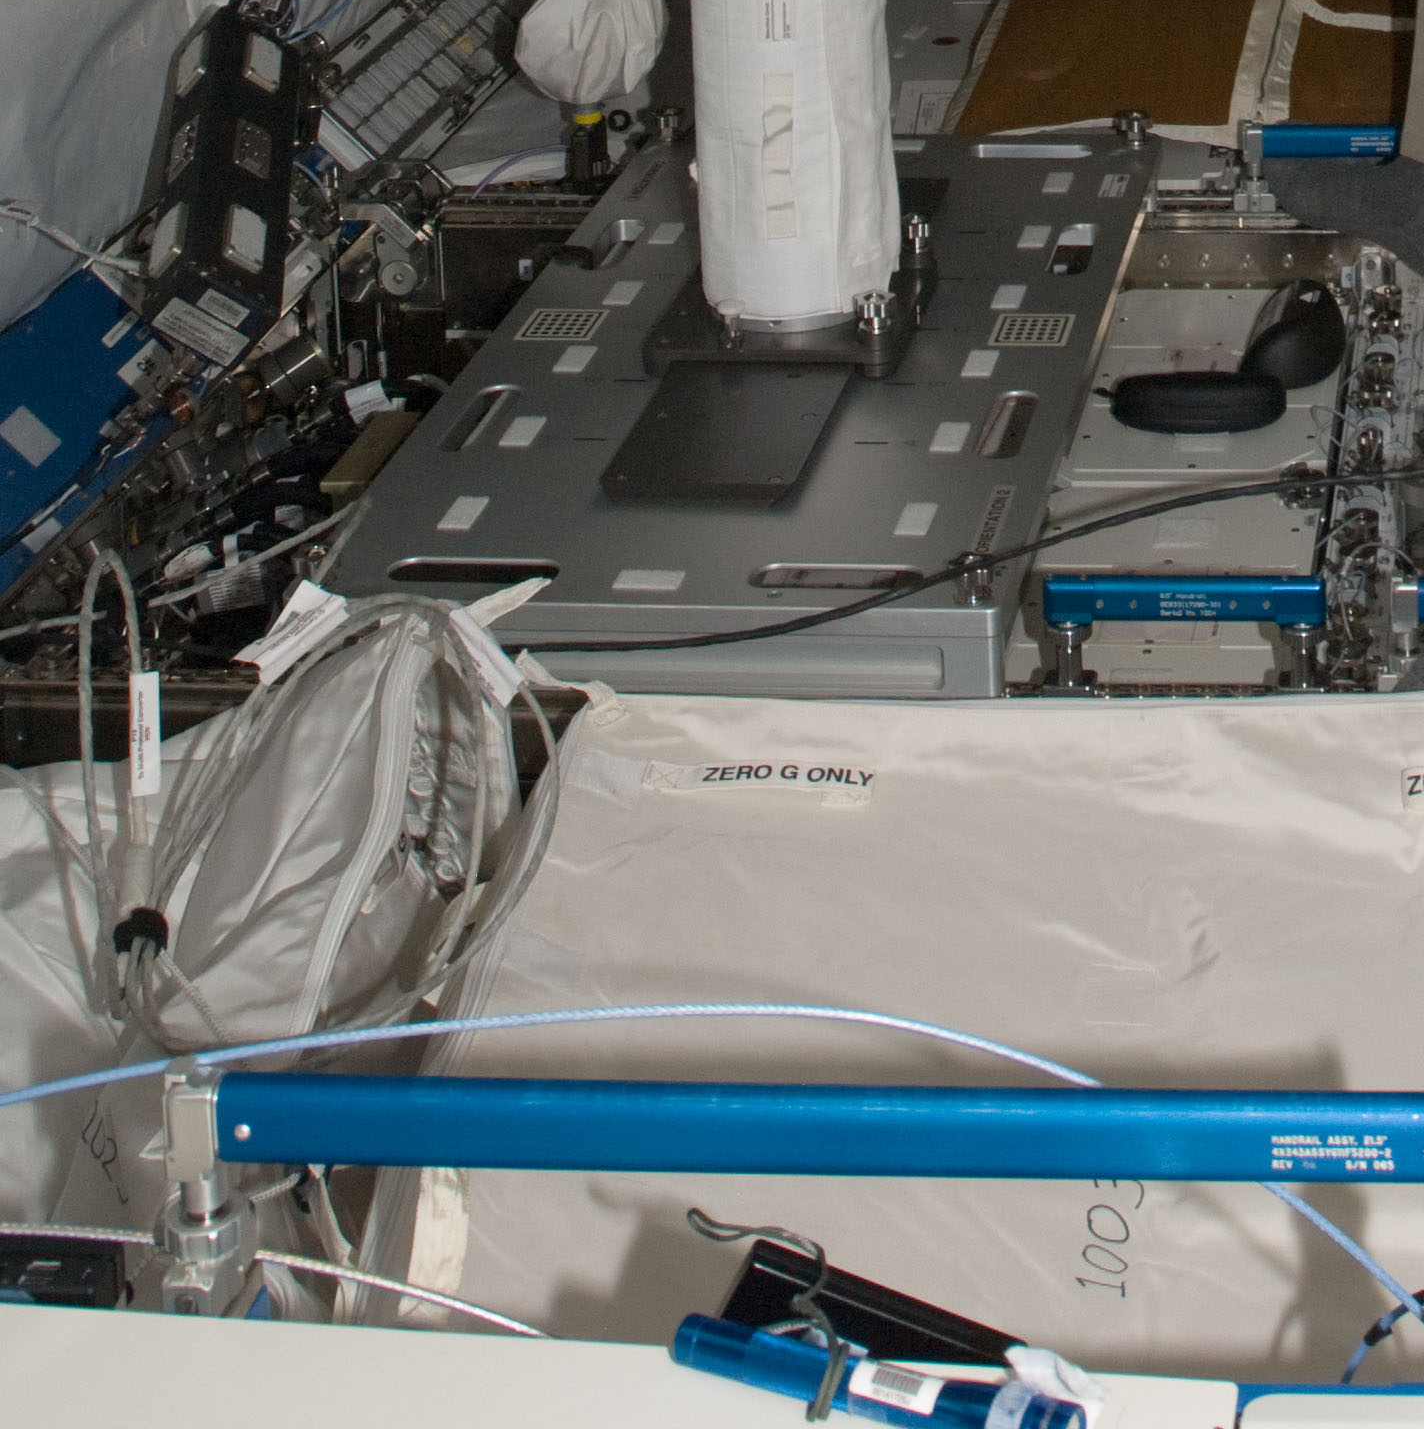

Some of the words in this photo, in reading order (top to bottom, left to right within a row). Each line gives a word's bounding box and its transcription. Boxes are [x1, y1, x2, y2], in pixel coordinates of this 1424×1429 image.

[975, 495, 1010, 553] ORIENTATION
[703, 762, 773, 784] ZERO
[780, 762, 800, 783] G
[807, 765, 875, 790] ONLY
[1271, 1135, 1322, 1145] HANDRAIL
[1327, 1135, 1358, 1146] ASSY,
[1271, 1159, 1294, 1170] REV
